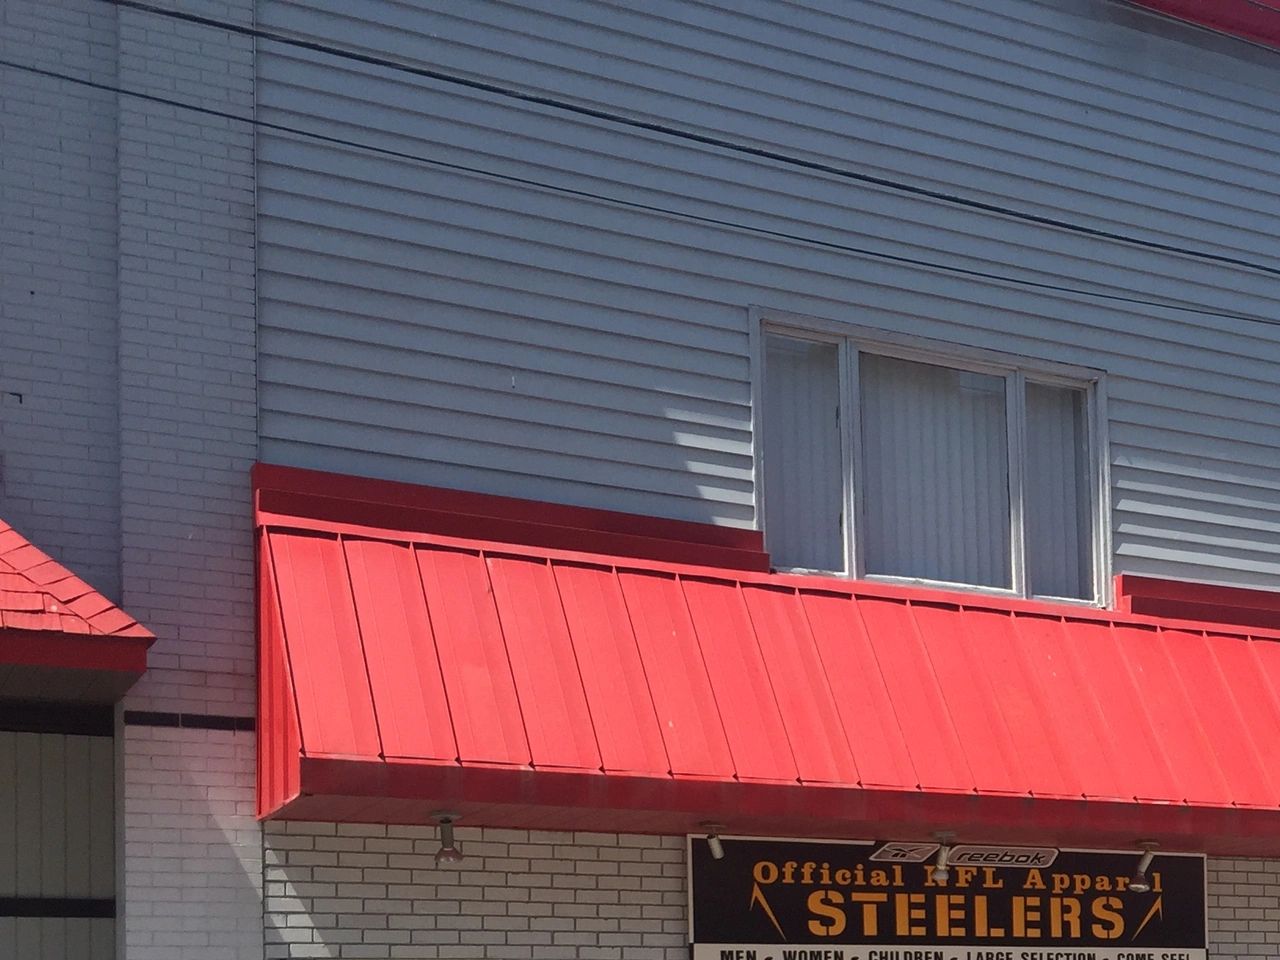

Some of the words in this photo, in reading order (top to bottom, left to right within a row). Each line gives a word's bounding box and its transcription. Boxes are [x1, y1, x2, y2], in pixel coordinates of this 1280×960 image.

[957, 850, 1046, 864] reebok
[752, 860, 904, 886] Official
[1023, 868, 1163, 894] Apparl
[807, 890, 1126, 939] STEELERS
